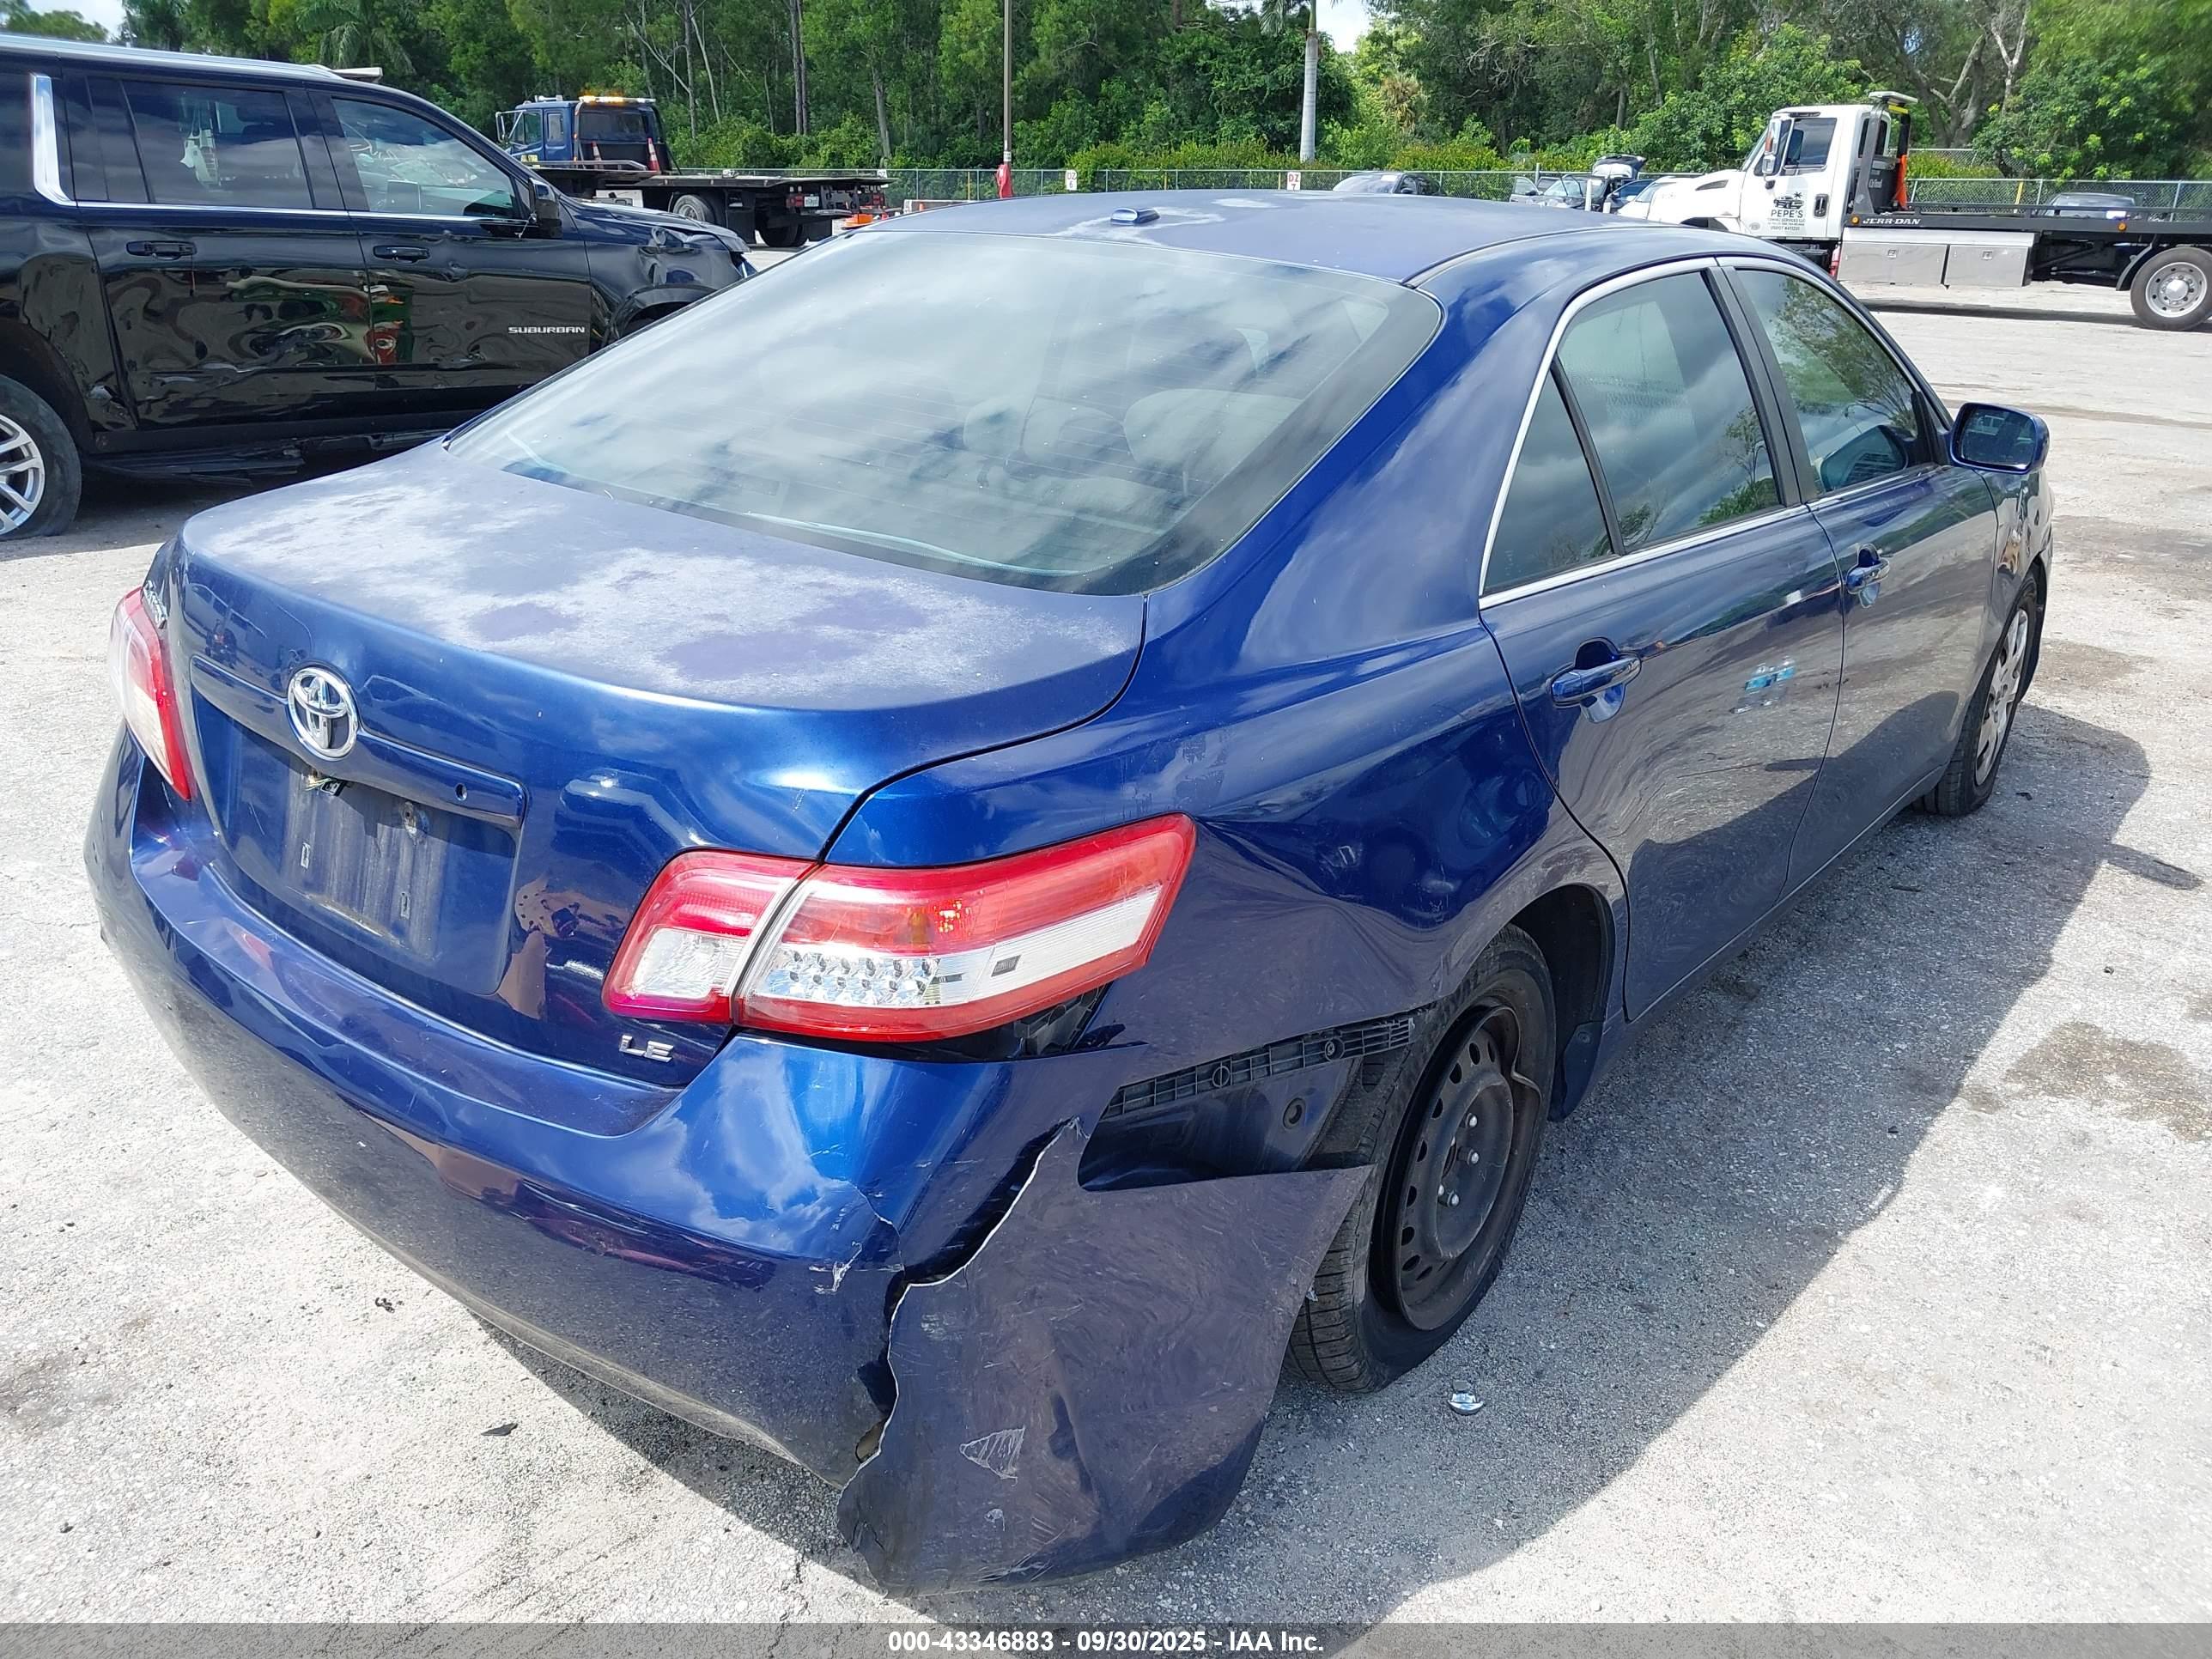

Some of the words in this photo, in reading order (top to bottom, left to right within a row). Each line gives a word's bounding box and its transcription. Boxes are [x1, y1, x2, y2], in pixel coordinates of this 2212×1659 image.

[1066, 172, 1077, 180] DZ
[1288, 173, 1299, 183] DZ
[1069, 180, 1073, 189] 6
[1771, 209, 1804, 218] PEPE'S
[619, 1035, 674, 1062] LE
